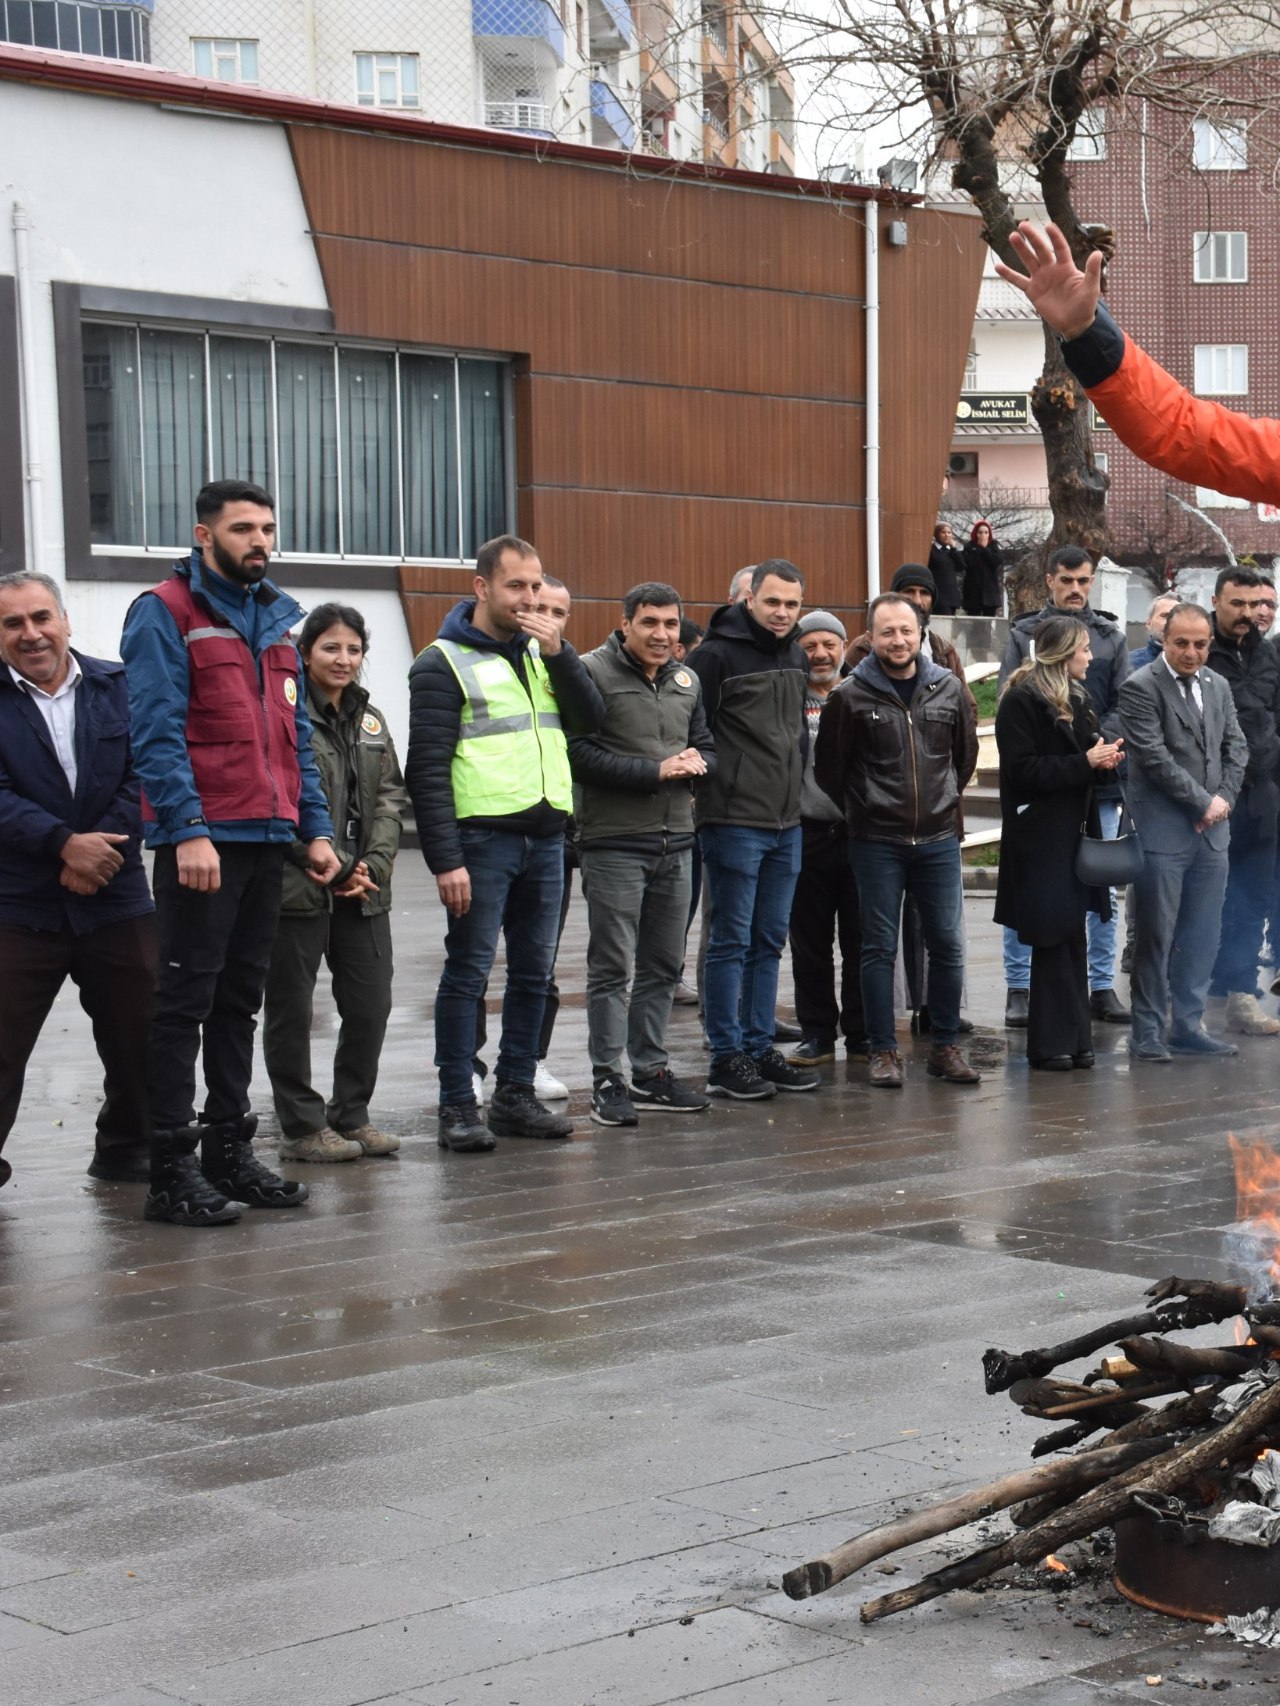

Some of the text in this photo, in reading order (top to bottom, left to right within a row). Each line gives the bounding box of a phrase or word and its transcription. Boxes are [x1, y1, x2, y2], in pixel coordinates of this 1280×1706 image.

[980, 400, 1016, 408] AVUKAT
[972, 409, 1026, 418] İSMAİL SELİM
